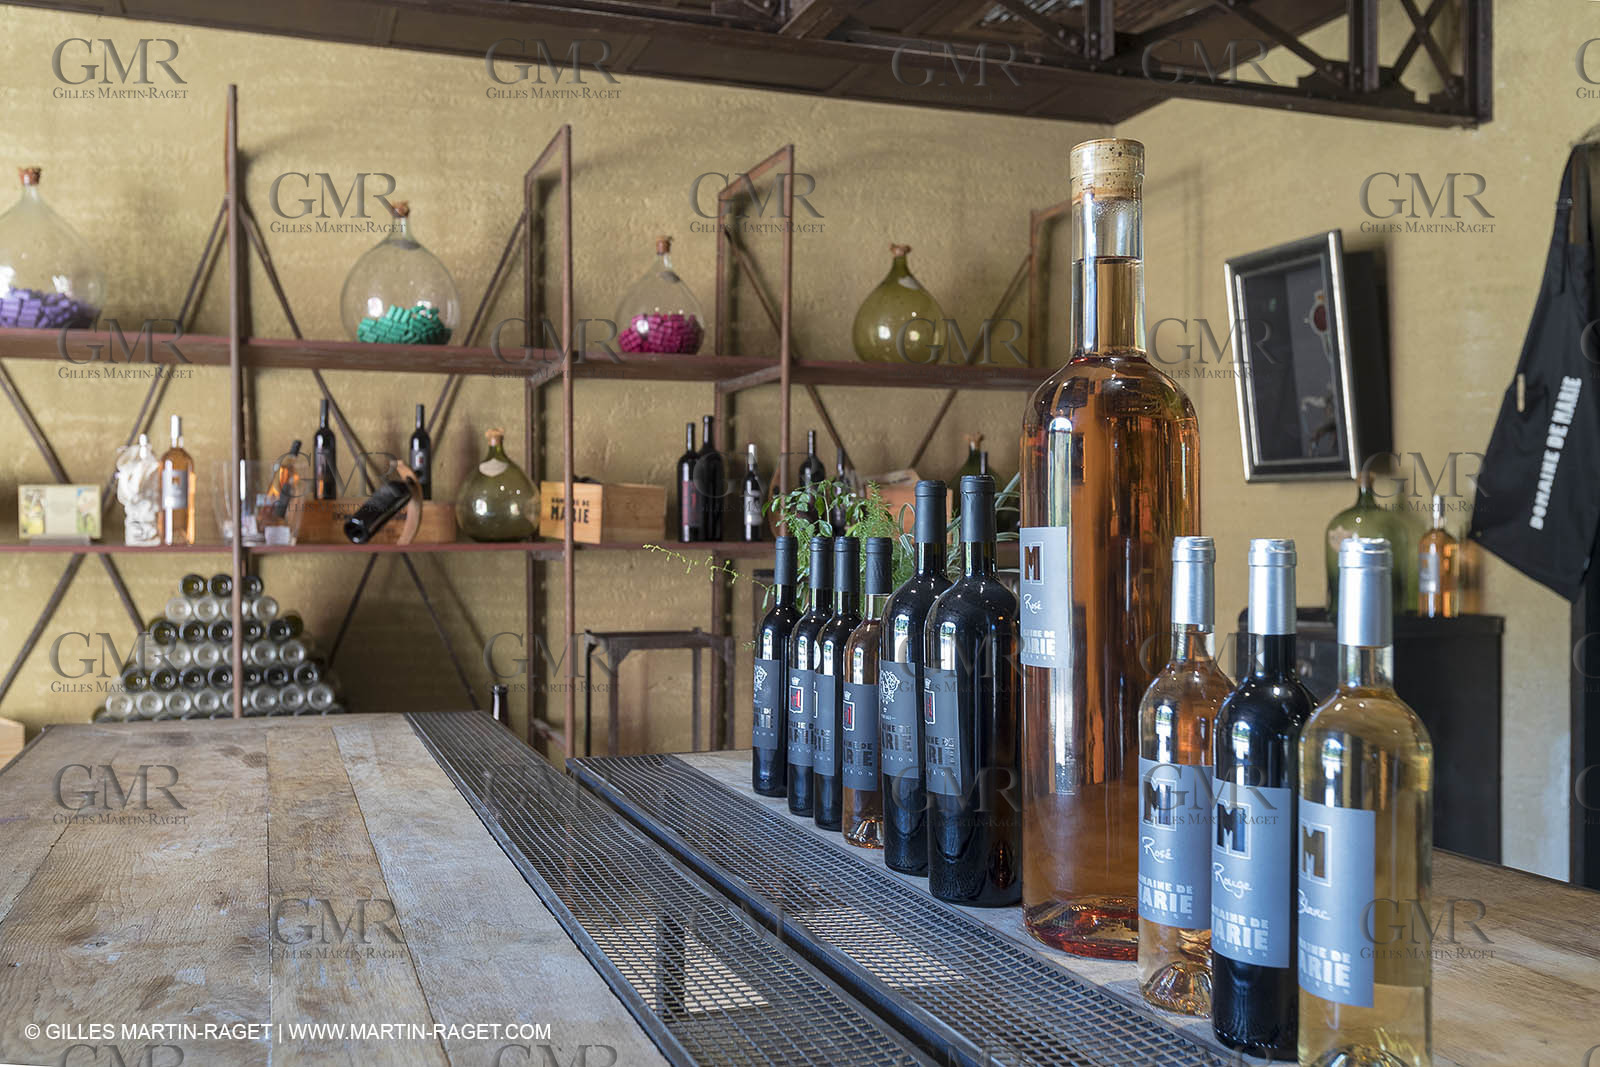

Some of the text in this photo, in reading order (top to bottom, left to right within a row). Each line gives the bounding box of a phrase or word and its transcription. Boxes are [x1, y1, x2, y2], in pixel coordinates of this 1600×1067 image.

[1529, 376, 1583, 531] DOMAINE DE MARIE
[551, 506, 589, 523] MAIE
[1024, 546, 1041, 581] M
[1143, 780, 1171, 826] M
[1217, 803, 1246, 853] M
[1302, 825, 1326, 879] M
[1176, 884, 1193, 895] DE
[1213, 862, 1252, 899] Rouge
[1250, 917, 1269, 929] DE
[1331, 950, 1352, 964] DE
